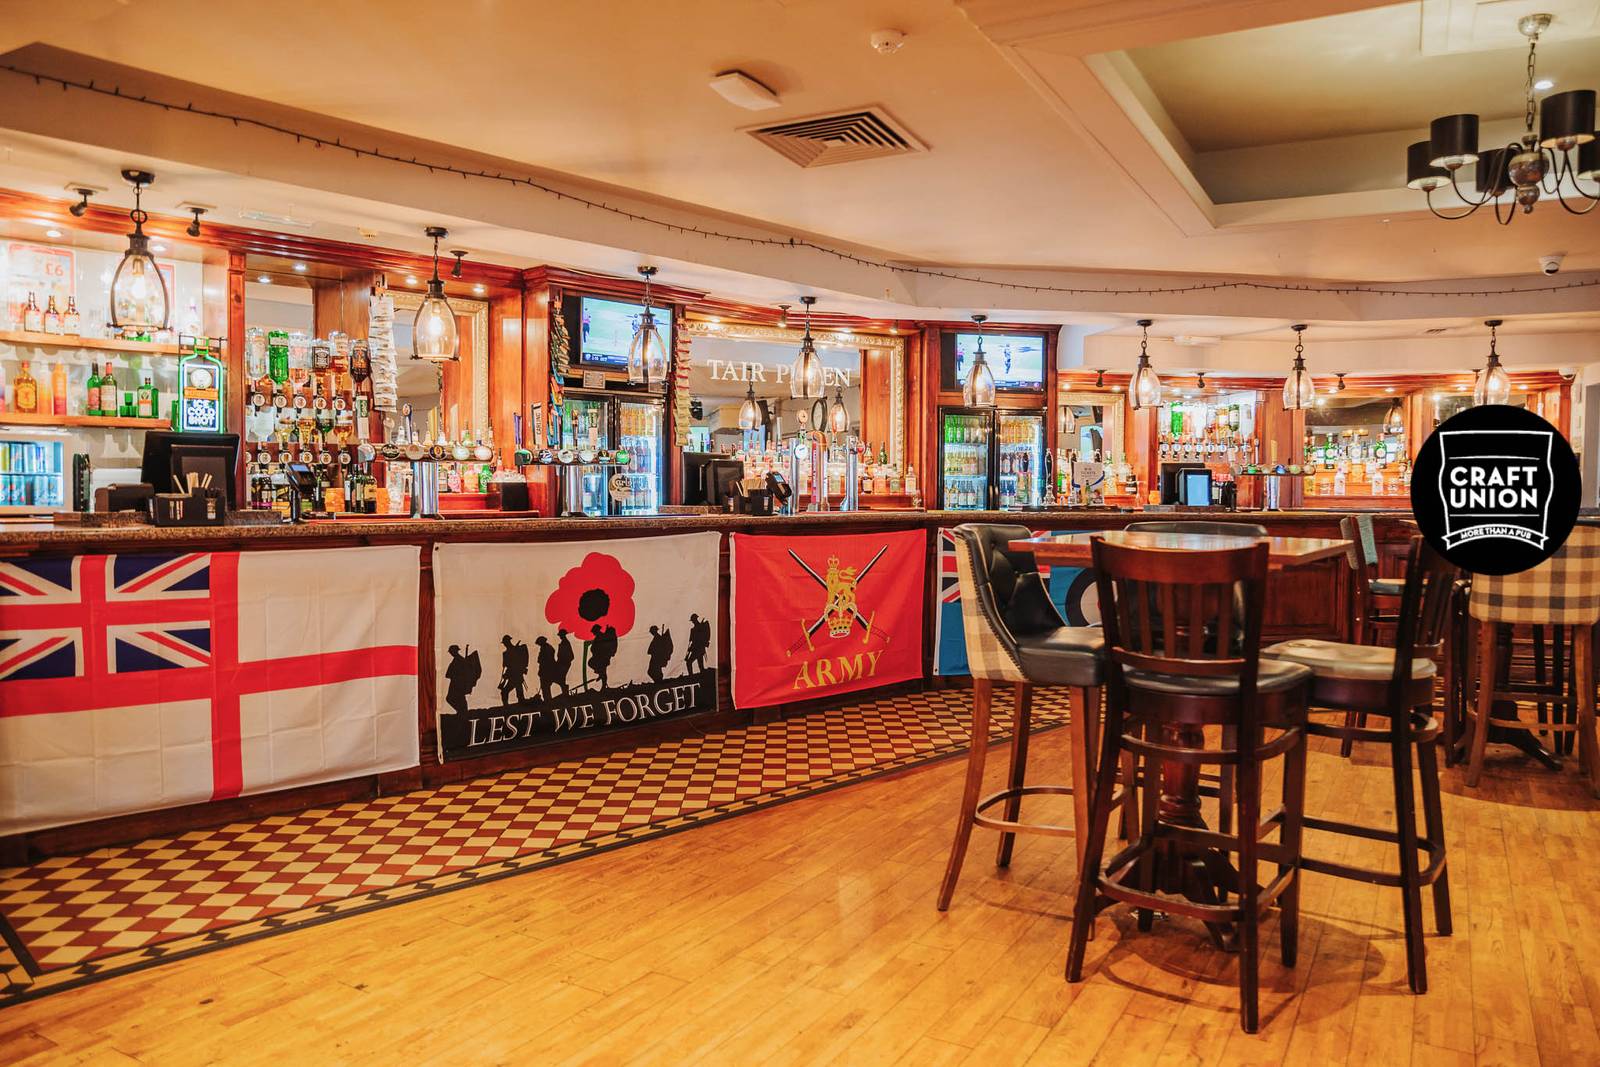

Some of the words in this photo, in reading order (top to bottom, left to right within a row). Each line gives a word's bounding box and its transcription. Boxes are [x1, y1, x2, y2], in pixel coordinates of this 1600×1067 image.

[707, 359, 767, 382] TAIR
[187, 407, 216, 418] COLD
[188, 415, 215, 427] SHOT
[792, 650, 884, 690] ARMY
[467, 711, 541, 747] LEST
[551, 704, 595, 733] WE
[600, 682, 701, 725] FORGET
